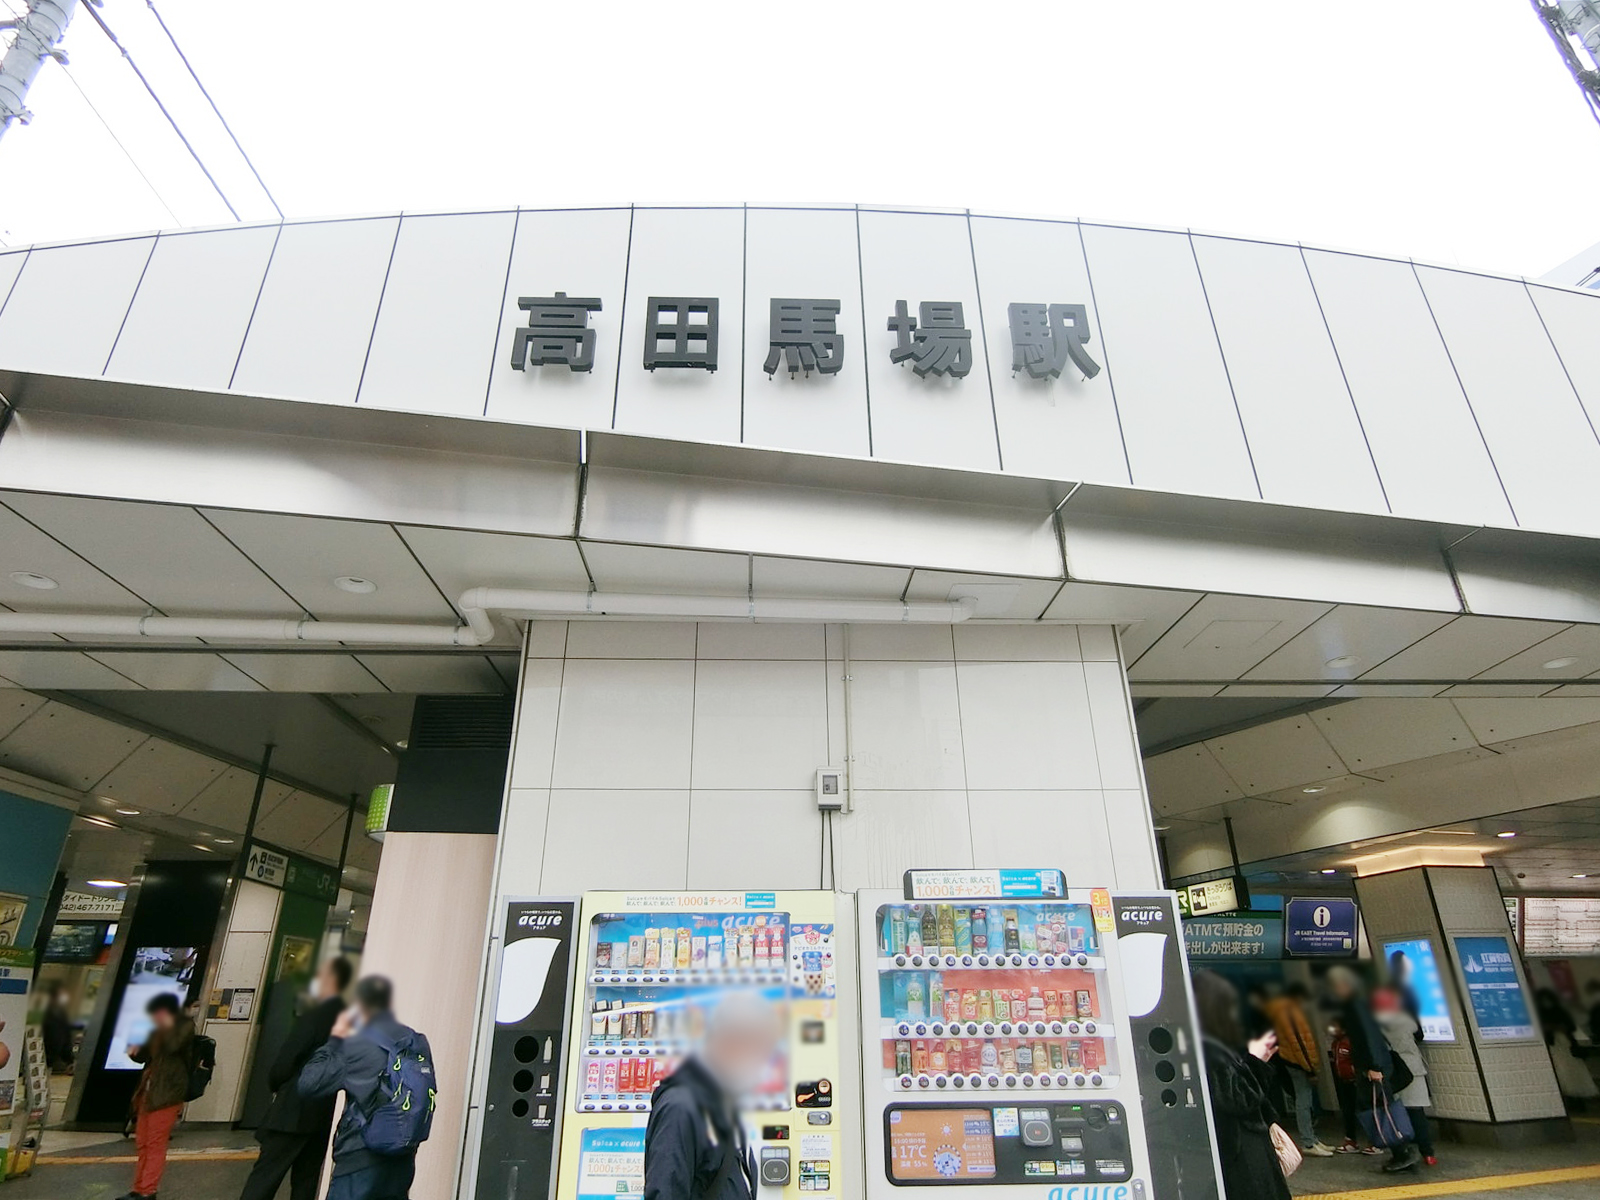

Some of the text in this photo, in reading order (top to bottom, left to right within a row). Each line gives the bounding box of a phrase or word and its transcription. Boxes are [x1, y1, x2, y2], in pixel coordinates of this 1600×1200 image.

[511, 292, 1101, 379] 高田馬場駅
[518, 915, 563, 926] acure
[721, 915, 781, 930] acue
[1121, 910, 1163, 921] acure
[1047, 1185, 1128, 1200] acure
